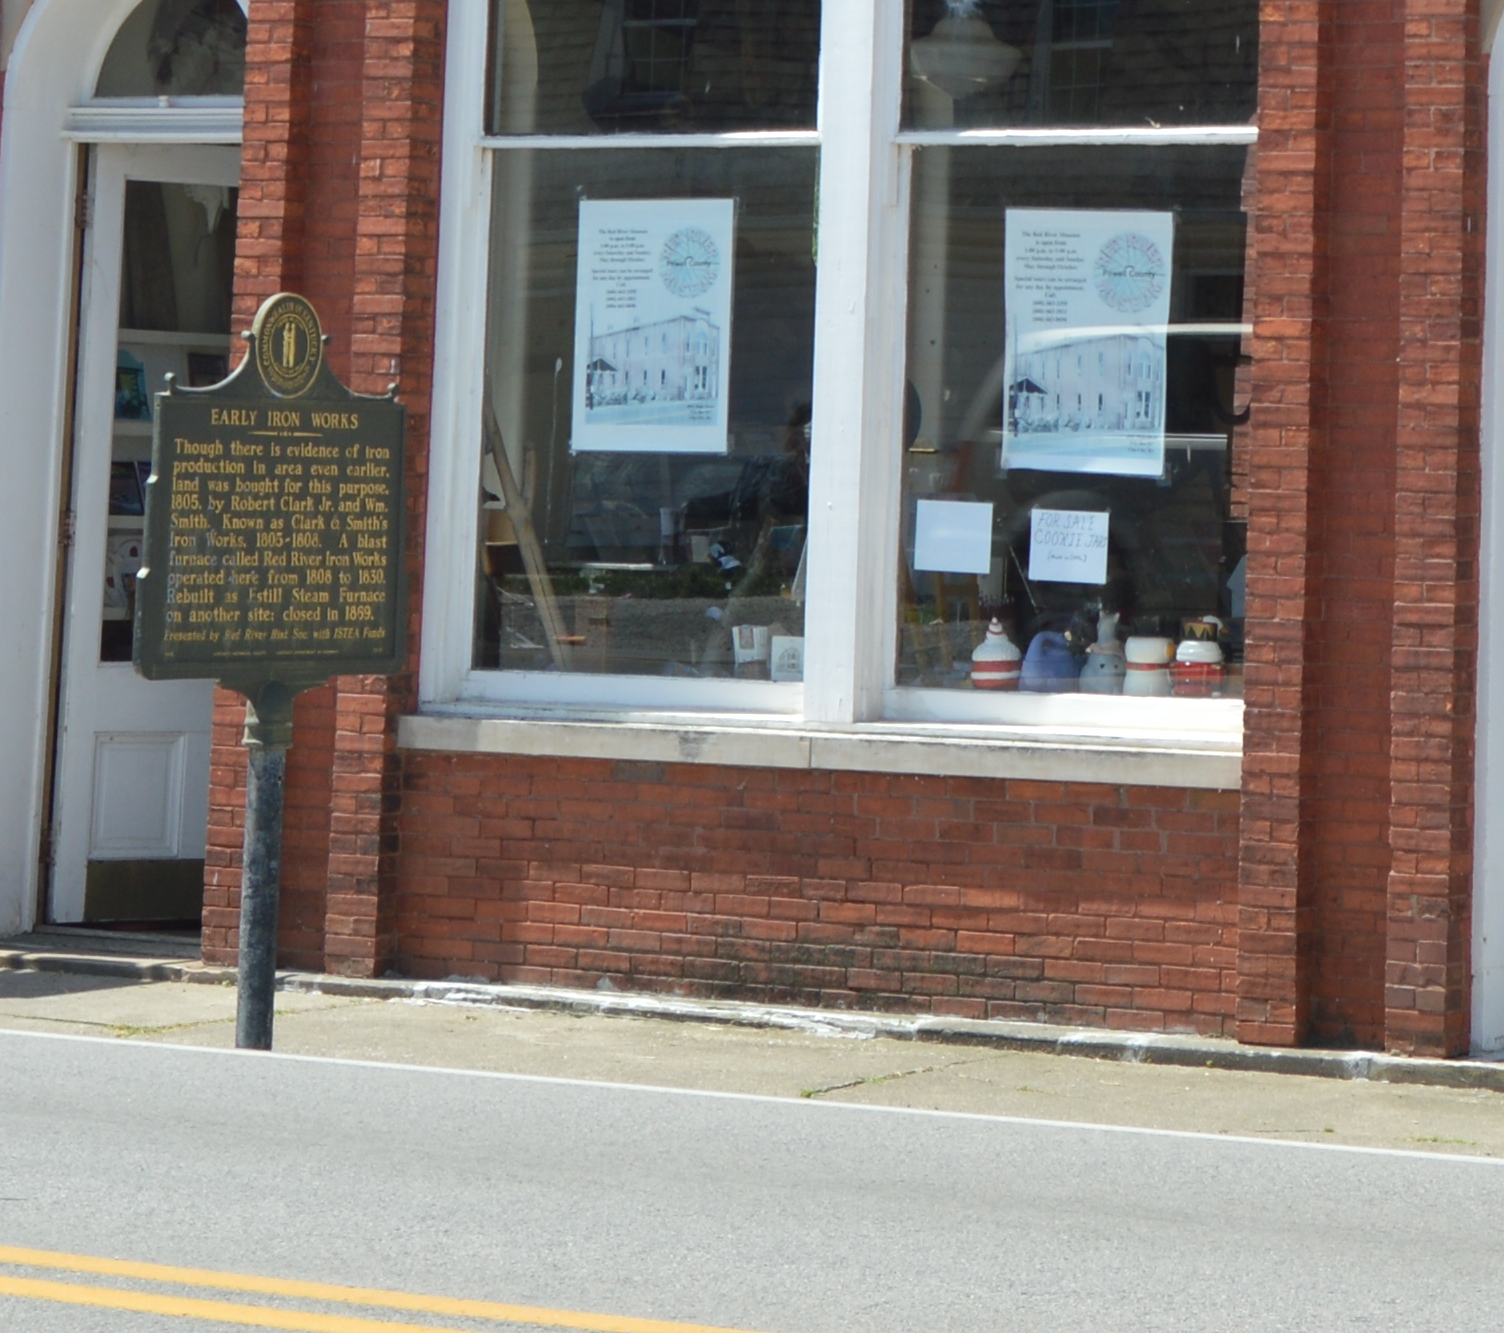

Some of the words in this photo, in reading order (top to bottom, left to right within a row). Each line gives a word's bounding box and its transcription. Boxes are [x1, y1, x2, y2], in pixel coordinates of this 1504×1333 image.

[1103, 268, 1127, 277] Powell
[1129, 269, 1155, 279] County
[210, 408, 257, 426] EARLY
[267, 411, 300, 427] IRON
[311, 412, 359, 430] WORKS
[174, 438, 223, 458] Though
[230, 440, 264, 456] there
[270, 441, 281, 457] is
[287, 442, 340, 458] evidence
[345, 443, 360, 458] of
[173, 458, 245, 477] production
[253, 461, 266, 475] in
[274, 463, 303, 476] area
[310, 463, 338, 476] even
[172, 476, 199, 493] land
[207, 479, 229, 492] was
[235, 477, 279, 497] bought
[283, 478, 303, 493] for
[308, 479, 332, 494] this
[207, 495, 225, 513] by
[231, 495, 276, 511] Robert
[280, 496, 314, 512] Clark
[318, 497, 335, 513] Jr.
[337, 496, 360, 513] and
[365, 498, 389, 513] Wm.
[222, 514, 264, 530] Known
[270, 517, 284, 530] as
[291, 514, 325, 530] Clark
[346, 514, 389, 530] Smith's
[1037, 511, 1061, 527] FOR
[1063, 514, 1096, 531] SALE
[169, 531, 196, 548] Iron
[338, 533, 348, 548] A
[357, 534, 387, 549] blast
[1034, 528, 1083, 547] COOKIE
[169, 550, 218, 567] furnace
[222, 551, 259, 567] called
[263, 551, 287, 566] Red
[290, 551, 322, 567] River
[325, 551, 350, 567] Iron
[352, 551, 387, 567] Works
[168, 569, 224, 588] operated
[231, 570, 260, 585] here
[267, 568, 299, 584] from
[306, 568, 332, 584] 1808
[338, 570, 352, 584] to
[166, 587, 215, 604] Rebuilt
[224, 591, 238, 603] as
[248, 586, 282, 603] Estill
[291, 587, 330, 603] Steam
[339, 587, 386, 603] Furnace
[166, 608, 182, 622] on
[189, 606, 241, 622] another
[282, 606, 321, 622] closed
[326, 606, 339, 621] in
[163, 628, 206, 642] Presented
[209, 628, 220, 642] by
[225, 628, 241, 640] Red
[245, 628, 267, 641] River
[313, 628, 331, 639] with
[334, 627, 359, 639] ISTEA
[363, 627, 386, 639] Funds
